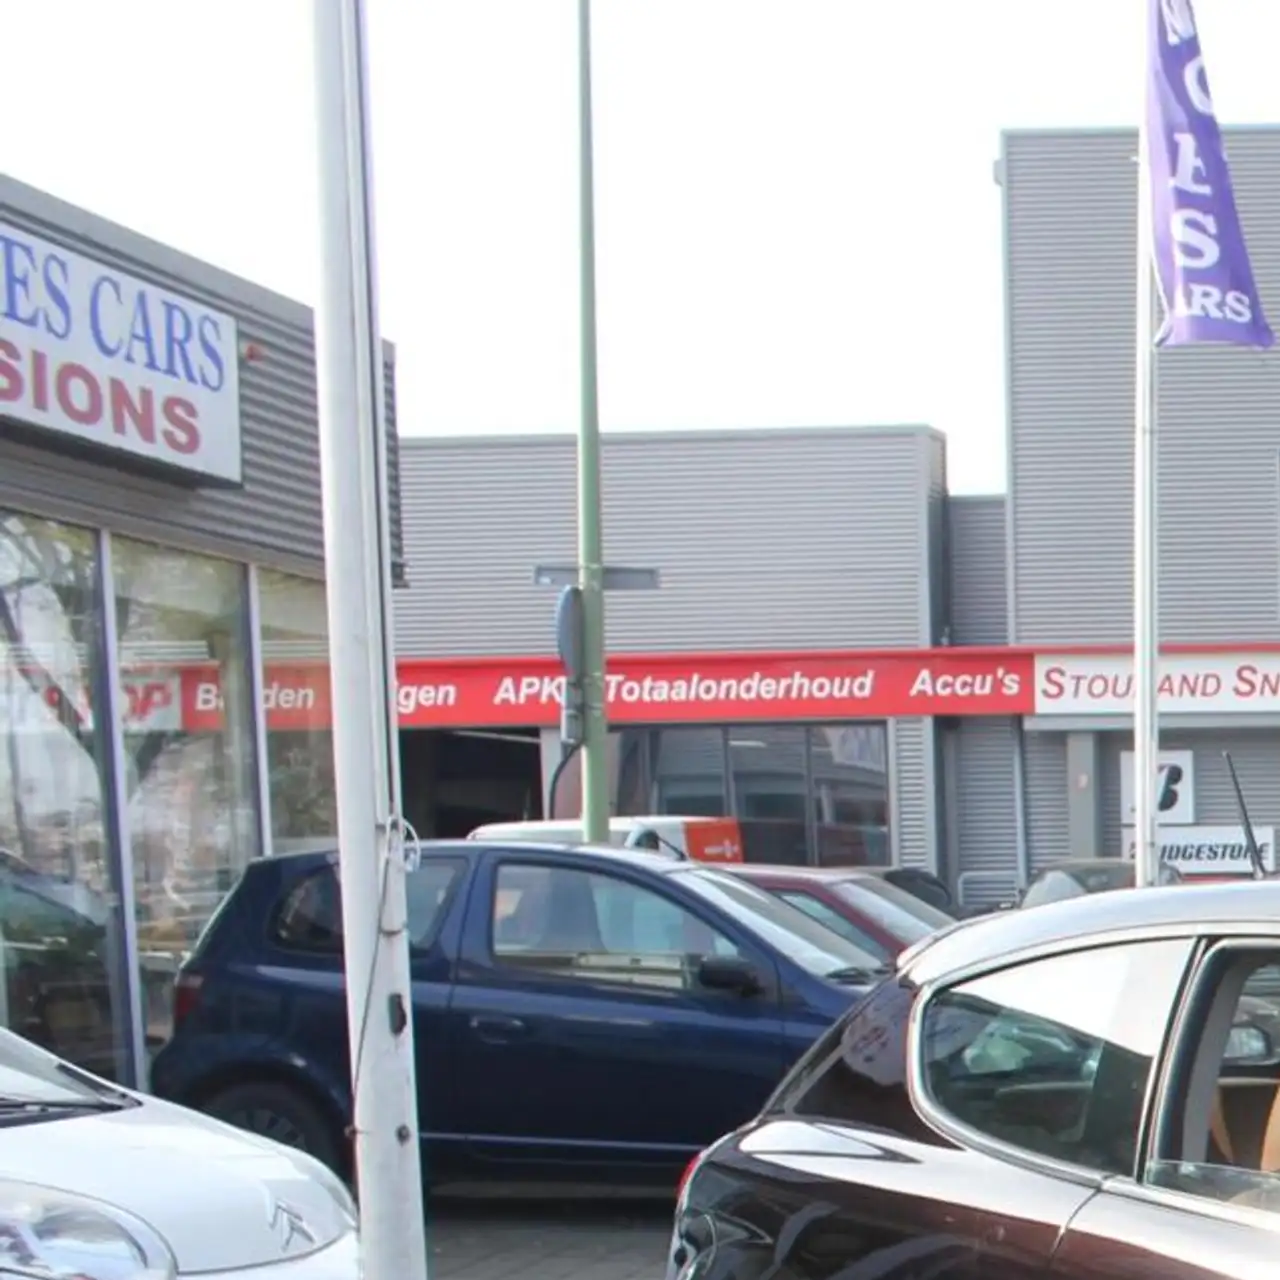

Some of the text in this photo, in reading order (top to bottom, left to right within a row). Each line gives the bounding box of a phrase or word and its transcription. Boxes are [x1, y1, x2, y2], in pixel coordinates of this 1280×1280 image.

[89, 275, 225, 392] CARS
[0, 338, 201, 454] SIONS
[195, 681, 315, 710] Bden
[493, 676, 568, 705] APK
[604, 669, 876, 704] Totaalonderhoud
[909, 667, 1020, 698] Accu's
[1041, 667, 1222, 699] STOUAND
